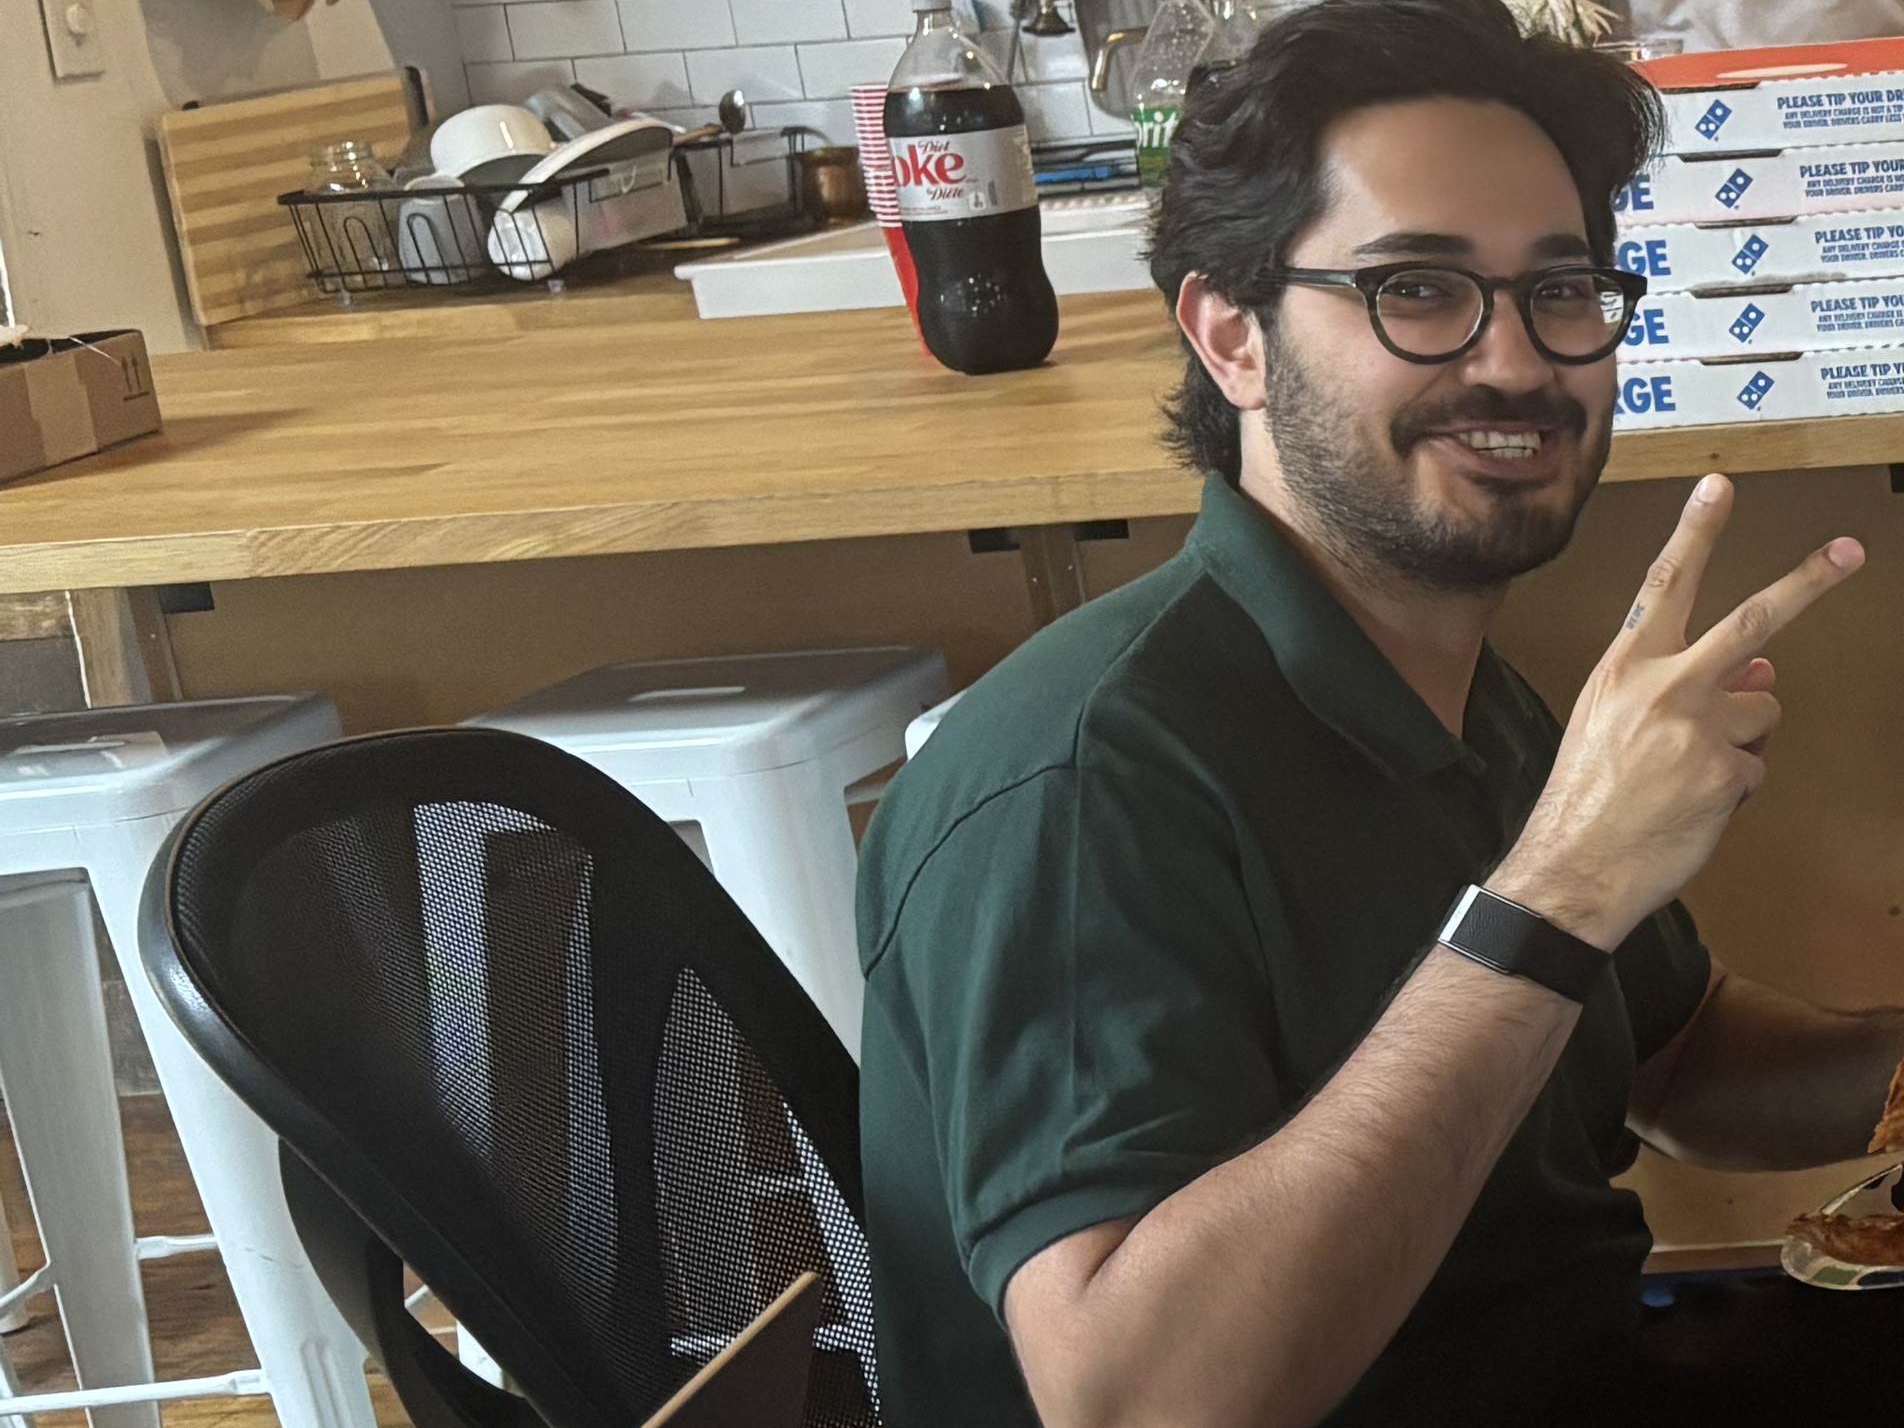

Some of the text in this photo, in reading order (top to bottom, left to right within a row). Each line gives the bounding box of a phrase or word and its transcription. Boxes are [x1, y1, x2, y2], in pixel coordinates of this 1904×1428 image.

[1777, 94, 1823, 110] PLEASE
[1826, 92, 1846, 106] TIP
[1849, 90, 1883, 105] YOUR
[893, 144, 967, 188] oke
[1800, 162, 1846, 178] PLEASE
[1851, 161, 1869, 174] TIP
[1815, 228, 1861, 244] PLEASE
[1864, 226, 1884, 240] TIP
[1811, 298, 1856, 313] PLEASE
[1860, 296, 1879, 310] TIP
[1821, 364, 1867, 380] PLEASE
[1870, 363, 1890, 376] TIP
